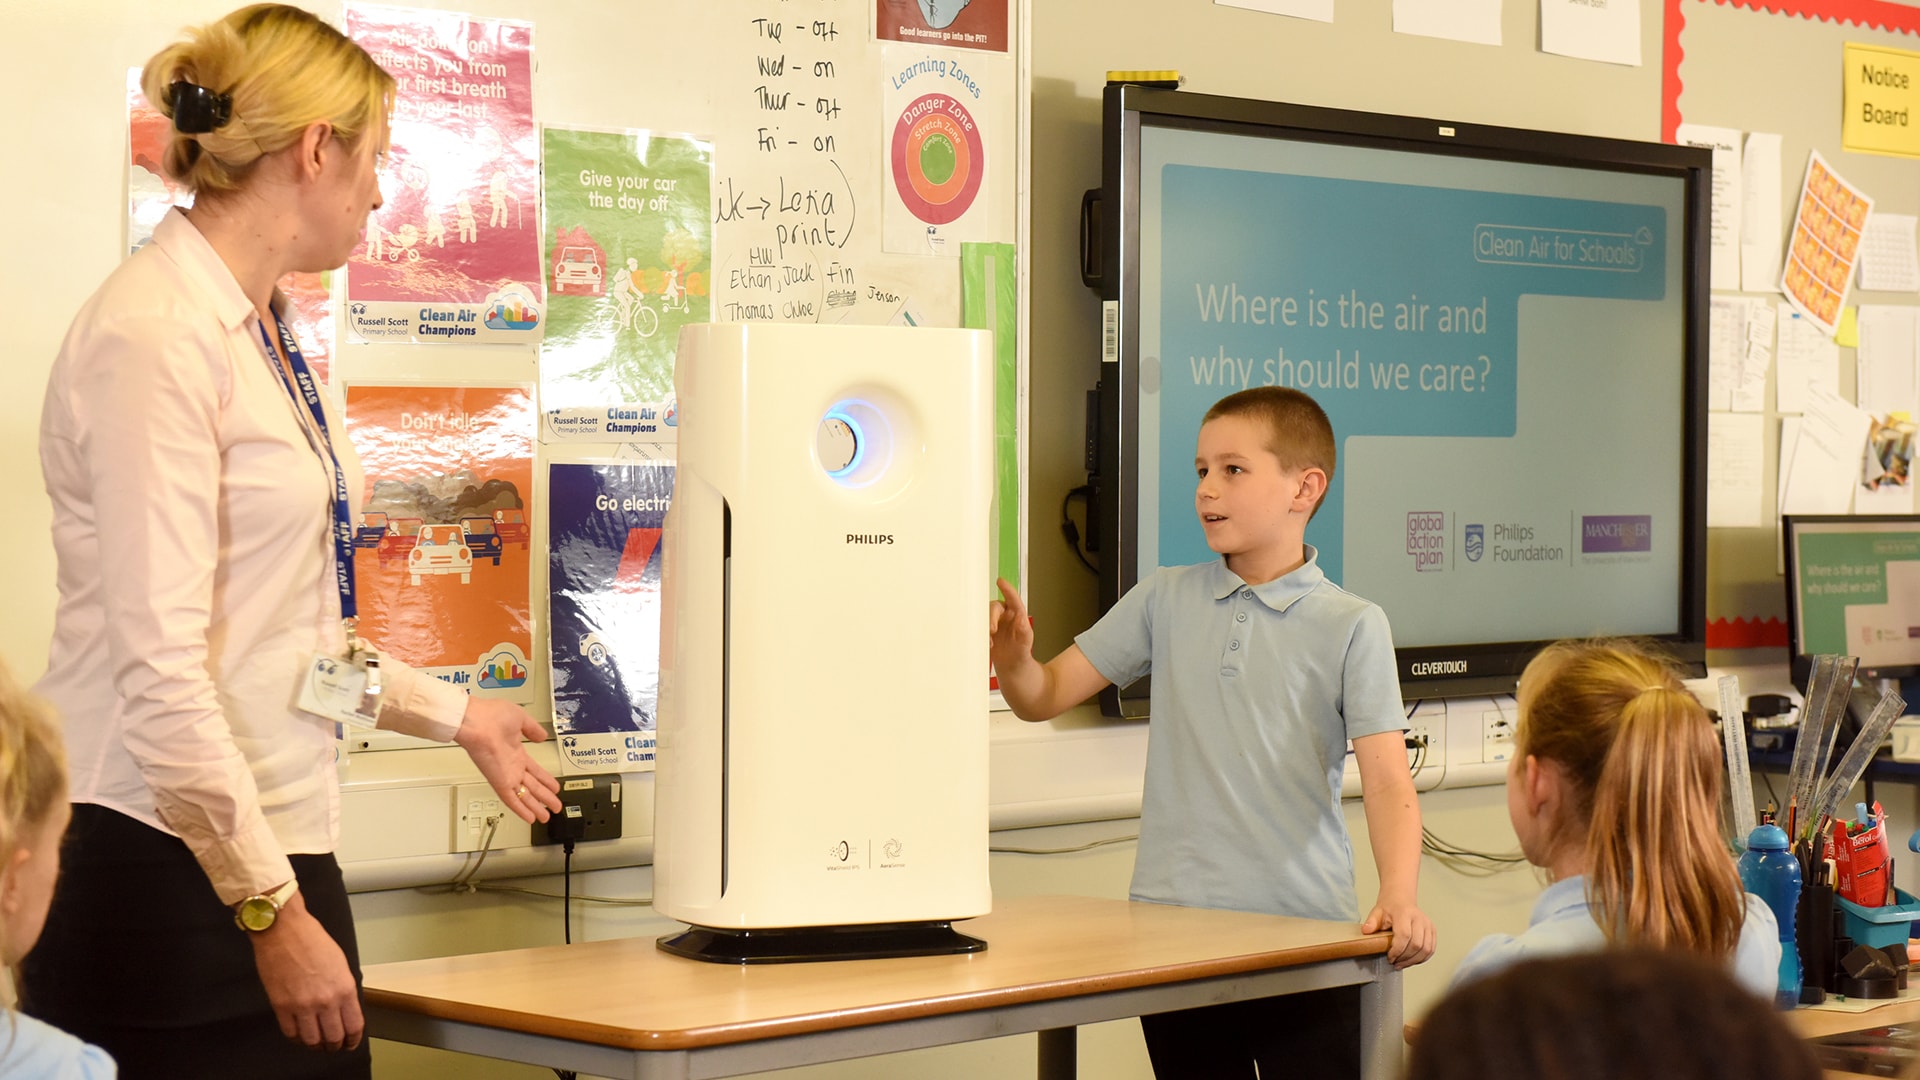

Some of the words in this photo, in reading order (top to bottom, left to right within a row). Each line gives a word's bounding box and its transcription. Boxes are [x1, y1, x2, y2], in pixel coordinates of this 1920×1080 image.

[812, 20, 838, 41] off
[899, 26, 916, 36] Good
[916, 28, 943, 39] learners
[943, 32, 951, 40] go
[952, 32, 964, 40] into
[964, 34, 974, 42] the
[975, 35, 988, 43] PIT!
[372, 49, 428, 71] affects
[433, 56, 463, 77] you
[467, 59, 507, 77] from
[757, 54, 785, 76] Wed
[814, 61, 835, 78] on
[414, 74, 448, 94] first
[452, 77, 508, 98] breath
[892, 55, 946, 90] Learning
[949, 60, 981, 99] Zones
[1862, 63, 1910, 90] Notice
[903, 98, 945, 126] Danger
[947, 100, 973, 132] Zone
[1863, 102, 1909, 127] Board
[914, 118, 943, 141] Stretch
[944, 121, 961, 144] Zone
[813, 135, 836, 152] on
[579, 169, 612, 187] Give
[616, 176, 649, 192] your
[653, 178, 677, 191] car
[588, 190, 613, 208] the
[617, 192, 645, 214] day
[649, 194, 669, 212] off
[776, 217, 836, 260] print
[1478, 231, 1525, 257] Clean
[1528, 235, 1550, 259] Air
[1553, 235, 1575, 261] for
[1578, 238, 1636, 265] Schools
[782, 262, 814, 286] Jack
[419, 308, 455, 322] Clean
[458, 309, 477, 323] Air
[724, 302, 775, 321] Thomas
[782, 300, 814, 319] Chloe
[1195, 282, 1298, 326] Where
[1308, 288, 1329, 328] is
[1337, 288, 1385, 330] the
[1394, 293, 1431, 332] air
[1438, 295, 1487, 334] and
[357, 317, 386, 326] Russell
[387, 318, 409, 327] Scott
[362, 327, 386, 336] Primary
[387, 328, 408, 336] School
[418, 324, 477, 338] Champions
[1189, 345, 1254, 391] why
[1262, 346, 1360, 391] should
[1369, 361, 1410, 391] we
[1419, 354, 1492, 393] care?
[297, 371, 319, 405] STAFF
[553, 416, 578, 425] Russell
[579, 416, 598, 425] Scott
[607, 407, 638, 420] Clean
[640, 408, 657, 420] Air
[557, 426, 578, 434] Primary
[606, 422, 657, 435] Champions
[595, 494, 619, 511] Go
[1409, 514, 1444, 536] global
[1494, 523, 1535, 543] Philips
[1585, 524, 1649, 538] MANCHER
[846, 534, 895, 545] PHILIPS
[1409, 532, 1444, 549] action
[1418, 550, 1444, 569] plan
[1493, 544, 1563, 562] Foundation
[336, 561, 351, 596] STAFF
[453, 671, 471, 684] Air
[1411, 660, 1467, 676] CLEVERTOUCH
[597, 748, 617, 756] Scott
[625, 737, 656, 749] Clean
[577, 757, 598, 766] Primary
[627, 752, 656, 762] Cham
